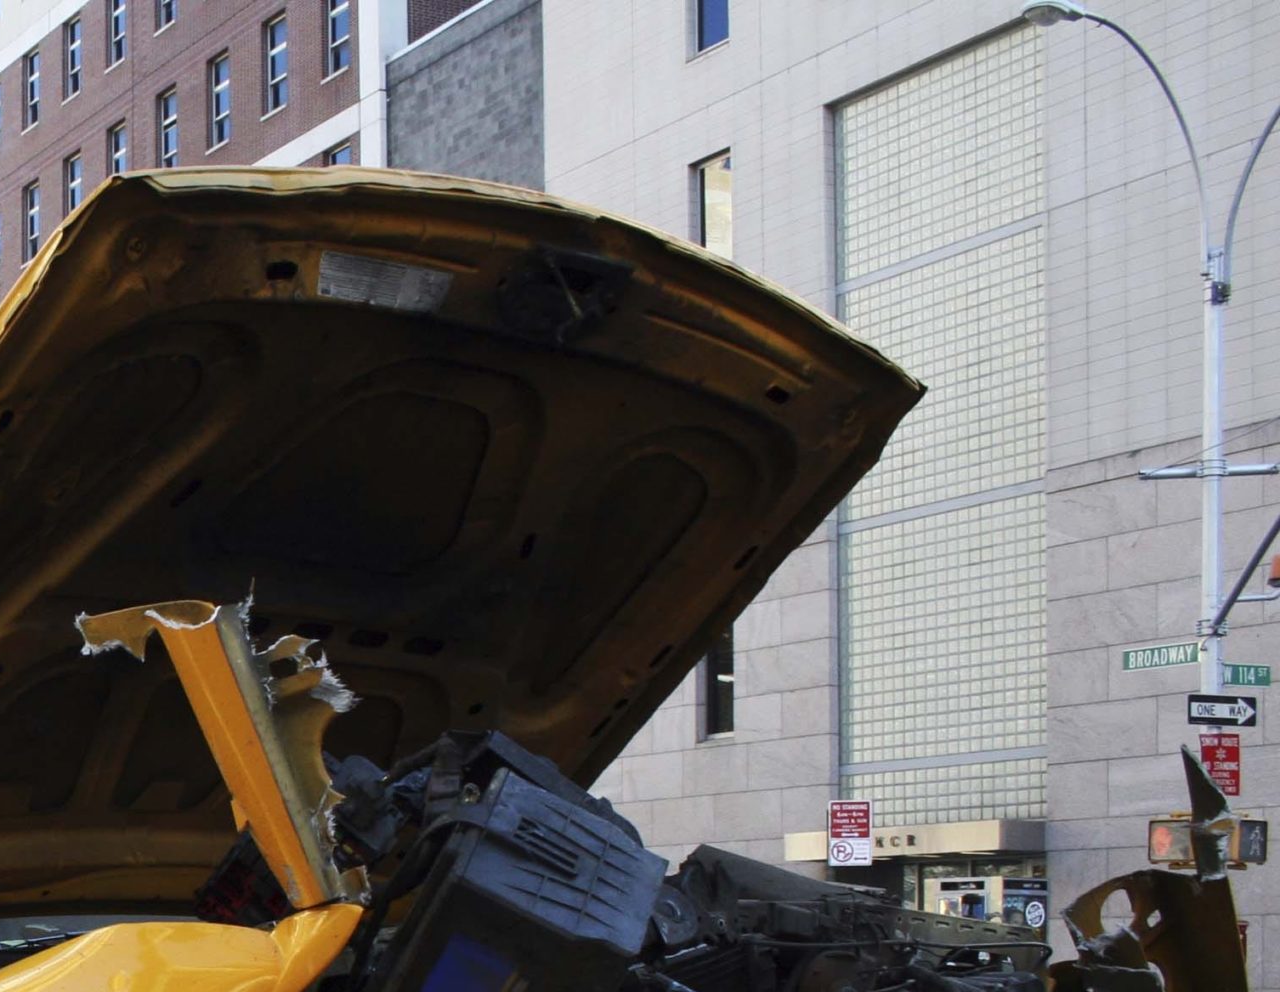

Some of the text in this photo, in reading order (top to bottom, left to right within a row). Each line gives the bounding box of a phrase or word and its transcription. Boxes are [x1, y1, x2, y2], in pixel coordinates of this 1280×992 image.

[1128, 644, 1194, 669] BROADWAY
[1223, 666, 1268, 684] W 114 ST
[1197, 703, 1248, 717] ONE WAY
